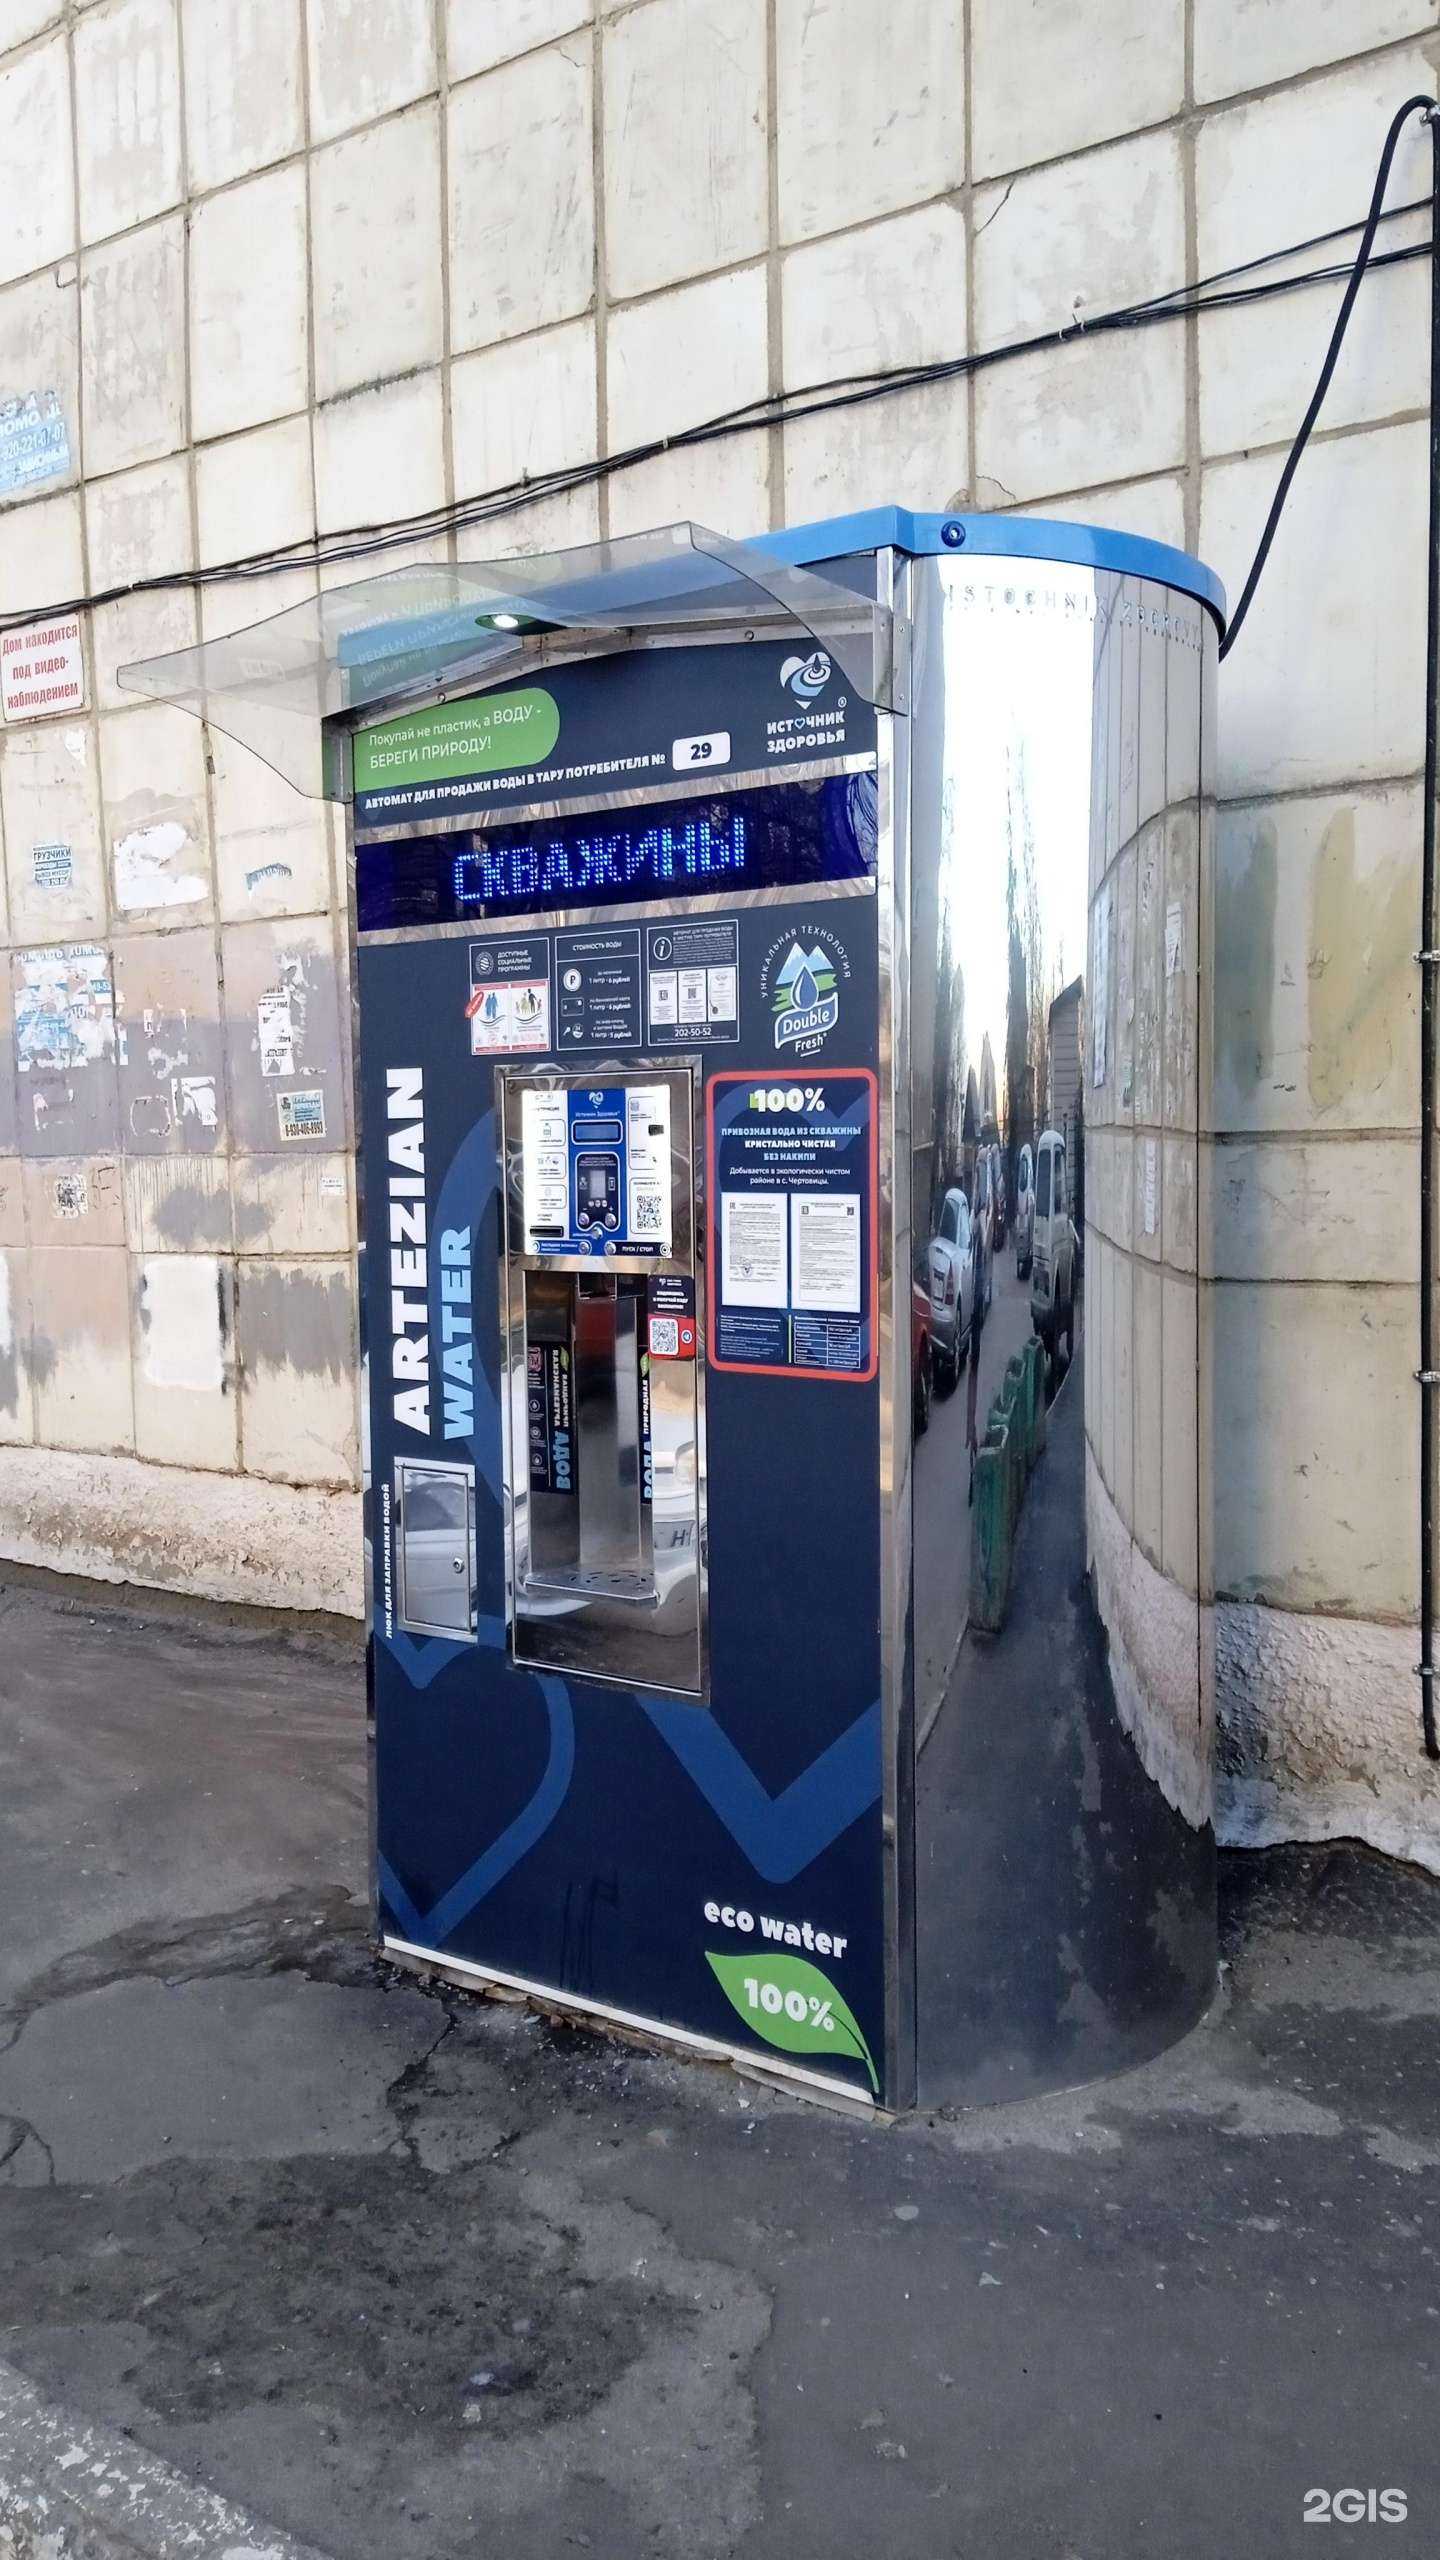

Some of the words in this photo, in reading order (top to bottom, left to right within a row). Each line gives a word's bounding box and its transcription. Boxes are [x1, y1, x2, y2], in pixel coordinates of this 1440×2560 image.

[3, 638, 22, 656] Дом
[25, 624, 78, 648] находится
[13, 663, 32, 680] под
[34, 656, 69, 676] видео-
[8, 682, 79, 709] наблюдением
[369, 728, 415, 746] Покупай
[417, 727, 431, 739] не
[433, 719, 481, 735] пластик,
[483, 716, 491, 727] а
[493, 704, 534, 725] ВОДУ
[370, 749, 419, 769] БЕРЕГИ
[421, 735, 492, 761] ПРИРОДУ!
[767, 729, 846, 753] ЗДОРОВЬЯ
[365, 793, 413, 809] АВТОМАТ
[414, 789, 436, 804] ДЛЯ
[436, 781, 492, 799] ПРОДАЖИ
[493, 774, 526, 790] ВОДЫ
[527, 773, 535, 785] В
[536, 768, 566, 784] ТАРУ
[566, 756, 650, 779] ПОТРЕБИТЕЛЯ
[690, 742, 713, 761] 29
[33, 848, 71, 861] ГРУЗЧИКИ
[454, 816, 745, 900] СКВАЖИНЫ
[497, 949, 529, 959] ДОСТУПНЫЕ
[572, 942, 605, 951] СТОИМОСТЬ
[606, 941, 622, 949] ВОДЫ
[497, 957, 532, 966] СОЦИАЛЬНЫЕ
[761, 928, 798, 999] УНИКАЛЬНАЯ
[801, 925, 851, 978] ТЕХНОЛОГИЯ
[674, 1027, 712, 1037] 202-50-52
[783, 1007, 830, 1035] Double
[795, 1036, 824, 1053] Fresh
[754, 1088, 826, 1112] 100%
[721, 1128, 771, 1136] ПРИВОЗНАЯ
[772, 1128, 795, 1137] ВОДА
[797, 1128, 808, 1136] ИЗ
[809, 1127, 862, 1135] СКВАЖИНЫ
[745, 1140, 801, 1149] КРИСТАЛЬНО
[802, 1140, 836, 1148] ЧИСТАЯ
[763, 1152, 779, 1161] БЕЗ
[780, 1152, 817, 1161] НАКИПИ
[729, 1167, 770, 1176] Добывается
[776, 1167, 824, 1176] экологически
[750, 1177, 775, 1186] районе
[386, 1067, 431, 1436] ARTEZIAN
[440, 1225, 475, 1440] WATER
[381, 1483, 390, 1523] ВОДОЙ
[383, 1524, 391, 1585] ЗАПРАВКИ
[384, 1586, 392, 1610] ДЛЯ
[385, 1611, 393, 1640] ЛЮК
[704, 1901, 755, 1933] eco
[760, 1916, 848, 1958] water
[744, 1978, 835, 2032] 100%
